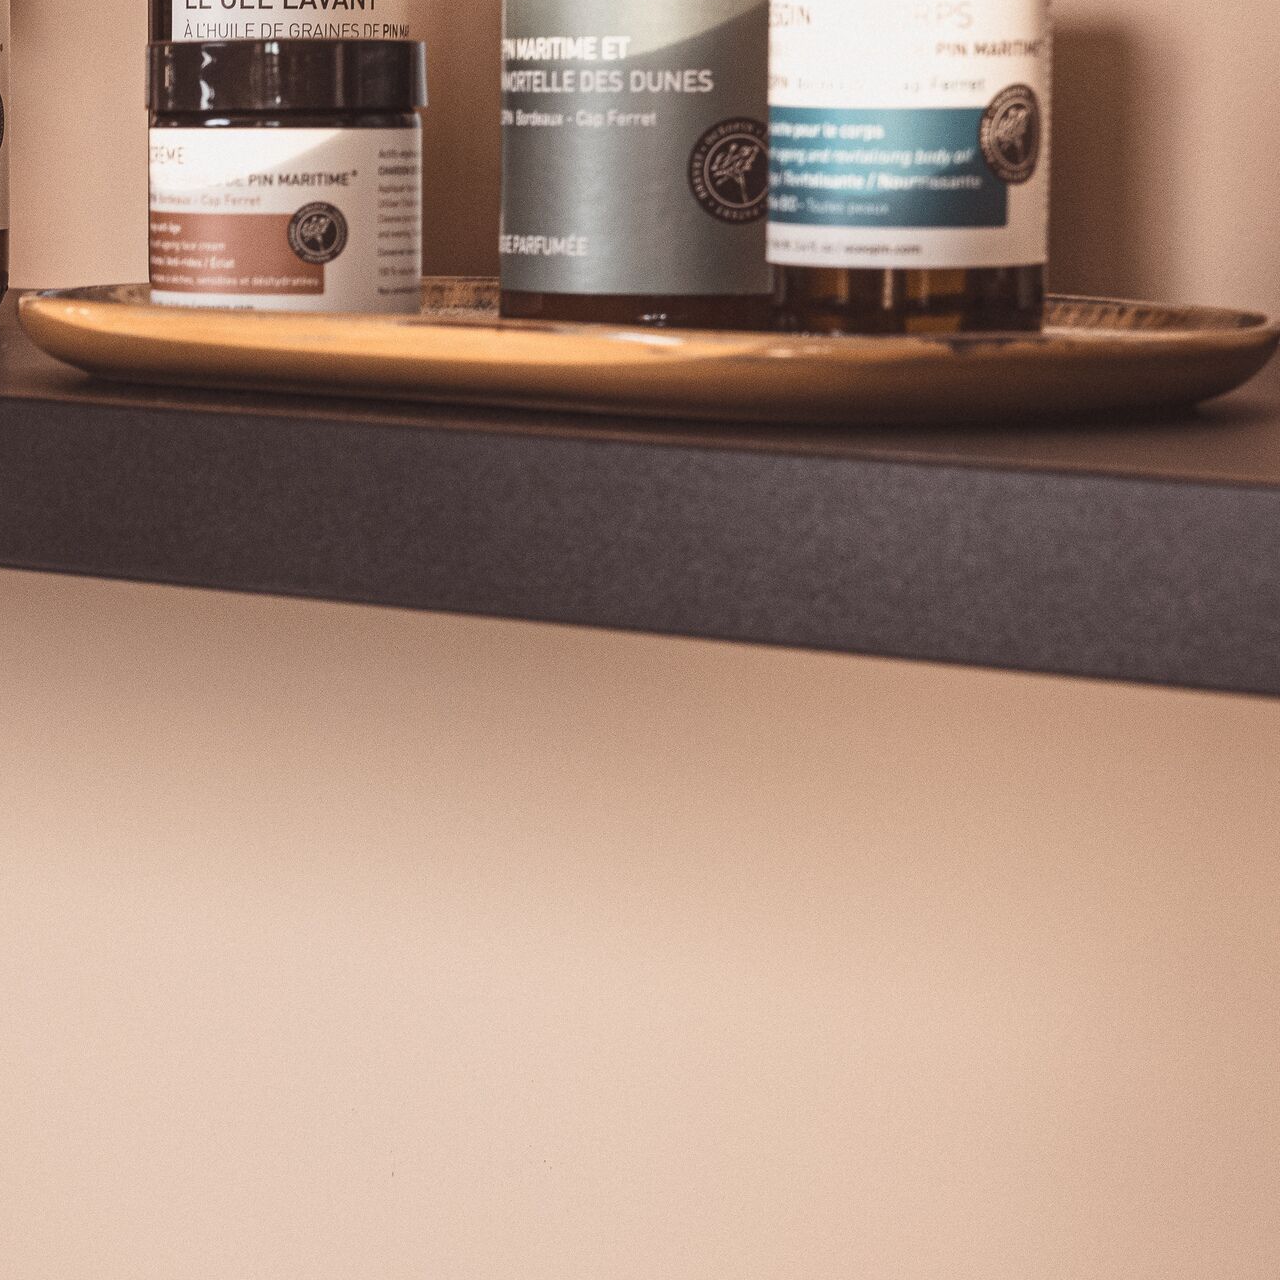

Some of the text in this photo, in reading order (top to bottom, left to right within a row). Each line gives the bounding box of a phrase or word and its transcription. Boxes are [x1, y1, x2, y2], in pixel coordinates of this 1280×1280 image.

[184, 18, 193, 38] À
[196, 23, 255, 38] L'HUILE
[261, 23, 284, 38] DE
[290, 23, 360, 38] GRAINES
[383, 23, 398, 38] PIN
[517, 36, 598, 60] MARITIME
[602, 36, 631, 60] ET
[580, 70, 624, 93] DES
[630, 69, 714, 93] DUNES
[607, 110, 657, 126] Ferret
[248, 174, 273, 186] PIN
